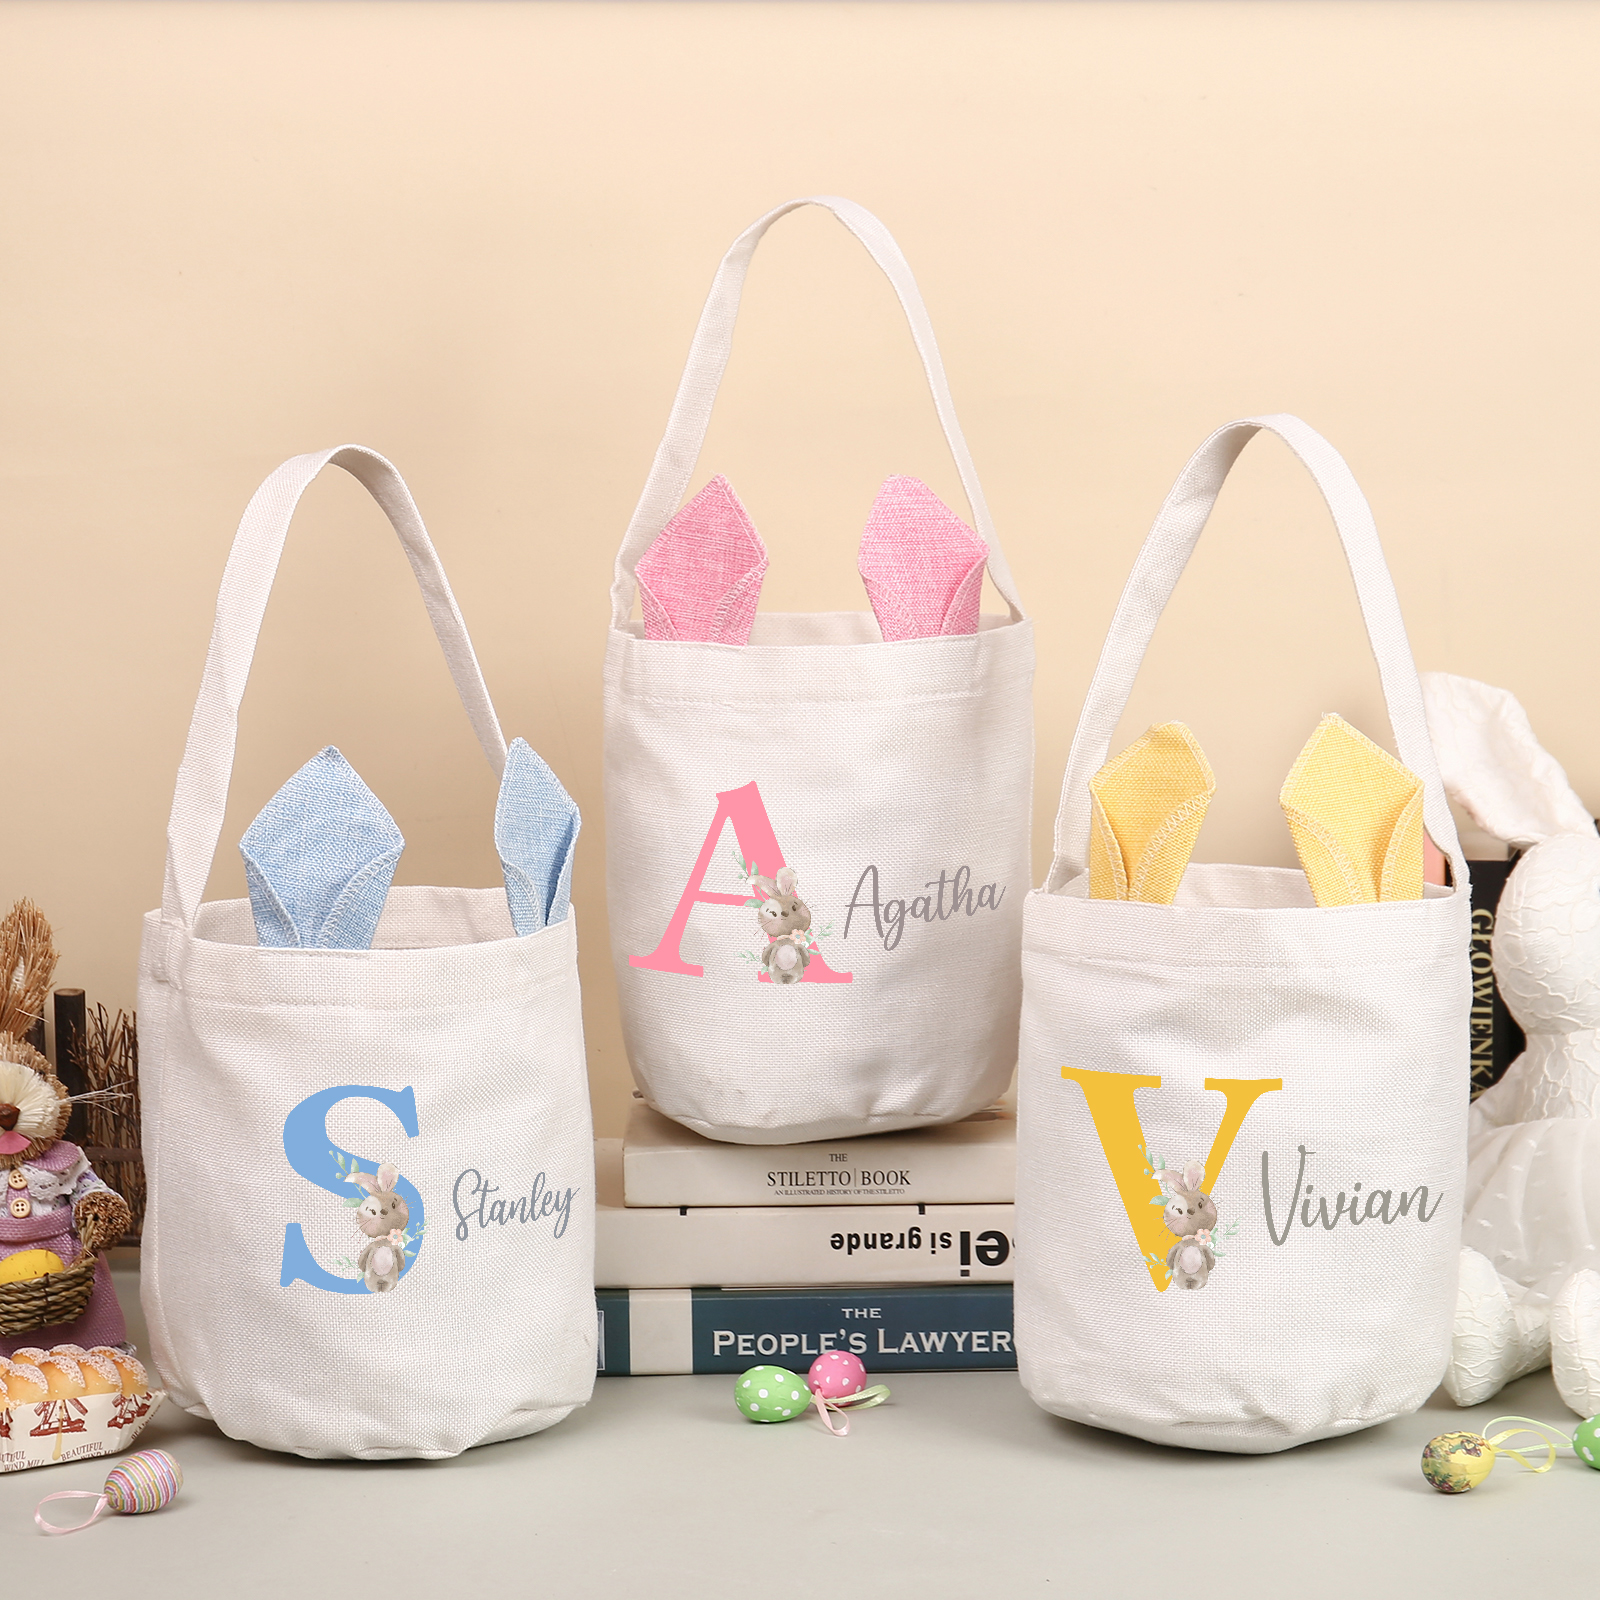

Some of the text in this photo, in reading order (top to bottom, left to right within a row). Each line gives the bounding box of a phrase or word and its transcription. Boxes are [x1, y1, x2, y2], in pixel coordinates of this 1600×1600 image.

[628, 780, 853, 984] A
[843, 864, 1007, 951] Agatha
[766, 1170, 911, 1187] STILETTO BOOK
[828, 1153, 848, 1163] THE
[1061, 1065, 1283, 1292] V
[280, 1085, 425, 1295] S
[452, 1168, 580, 1241] Stanley
[1261, 1144, 1444, 1247] Vivian
[830, 1227, 1015, 1278] ei si grande
[841, 1308, 882, 1319] THE
[877, 1328, 1013, 1354] LAWYER
[4, 1460, 25, 1472] WIND
[61, 1441, 104, 1461] BEAUTIFUL
